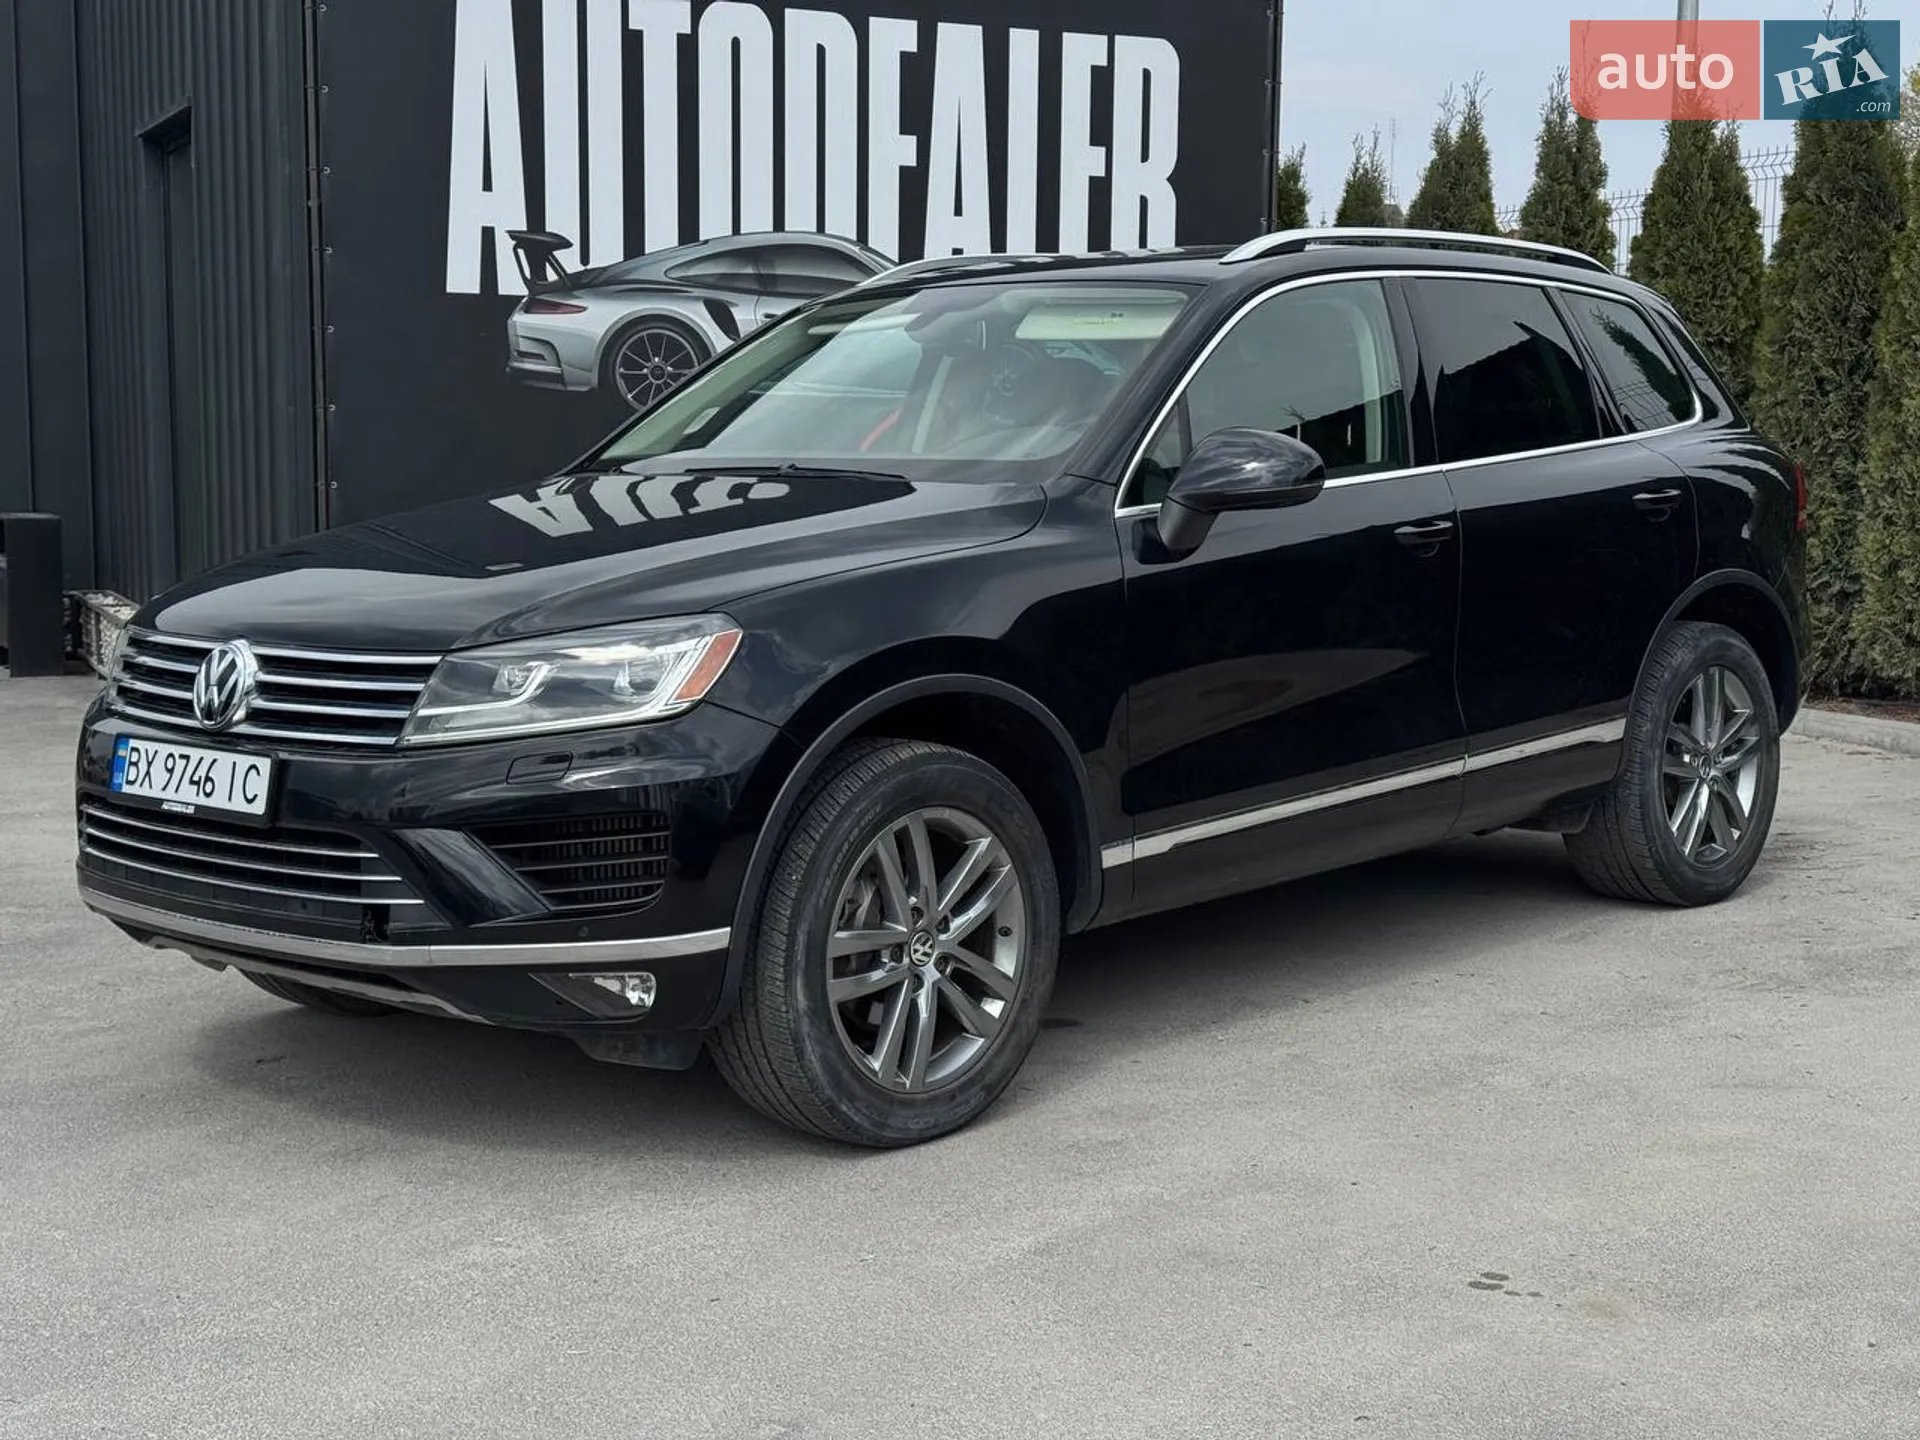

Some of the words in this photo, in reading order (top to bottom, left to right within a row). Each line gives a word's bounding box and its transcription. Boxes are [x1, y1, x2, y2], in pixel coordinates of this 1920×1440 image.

[125, 746, 158, 789] BX
[161, 752, 218, 798] 9746
[228, 760, 261, 804] IC
